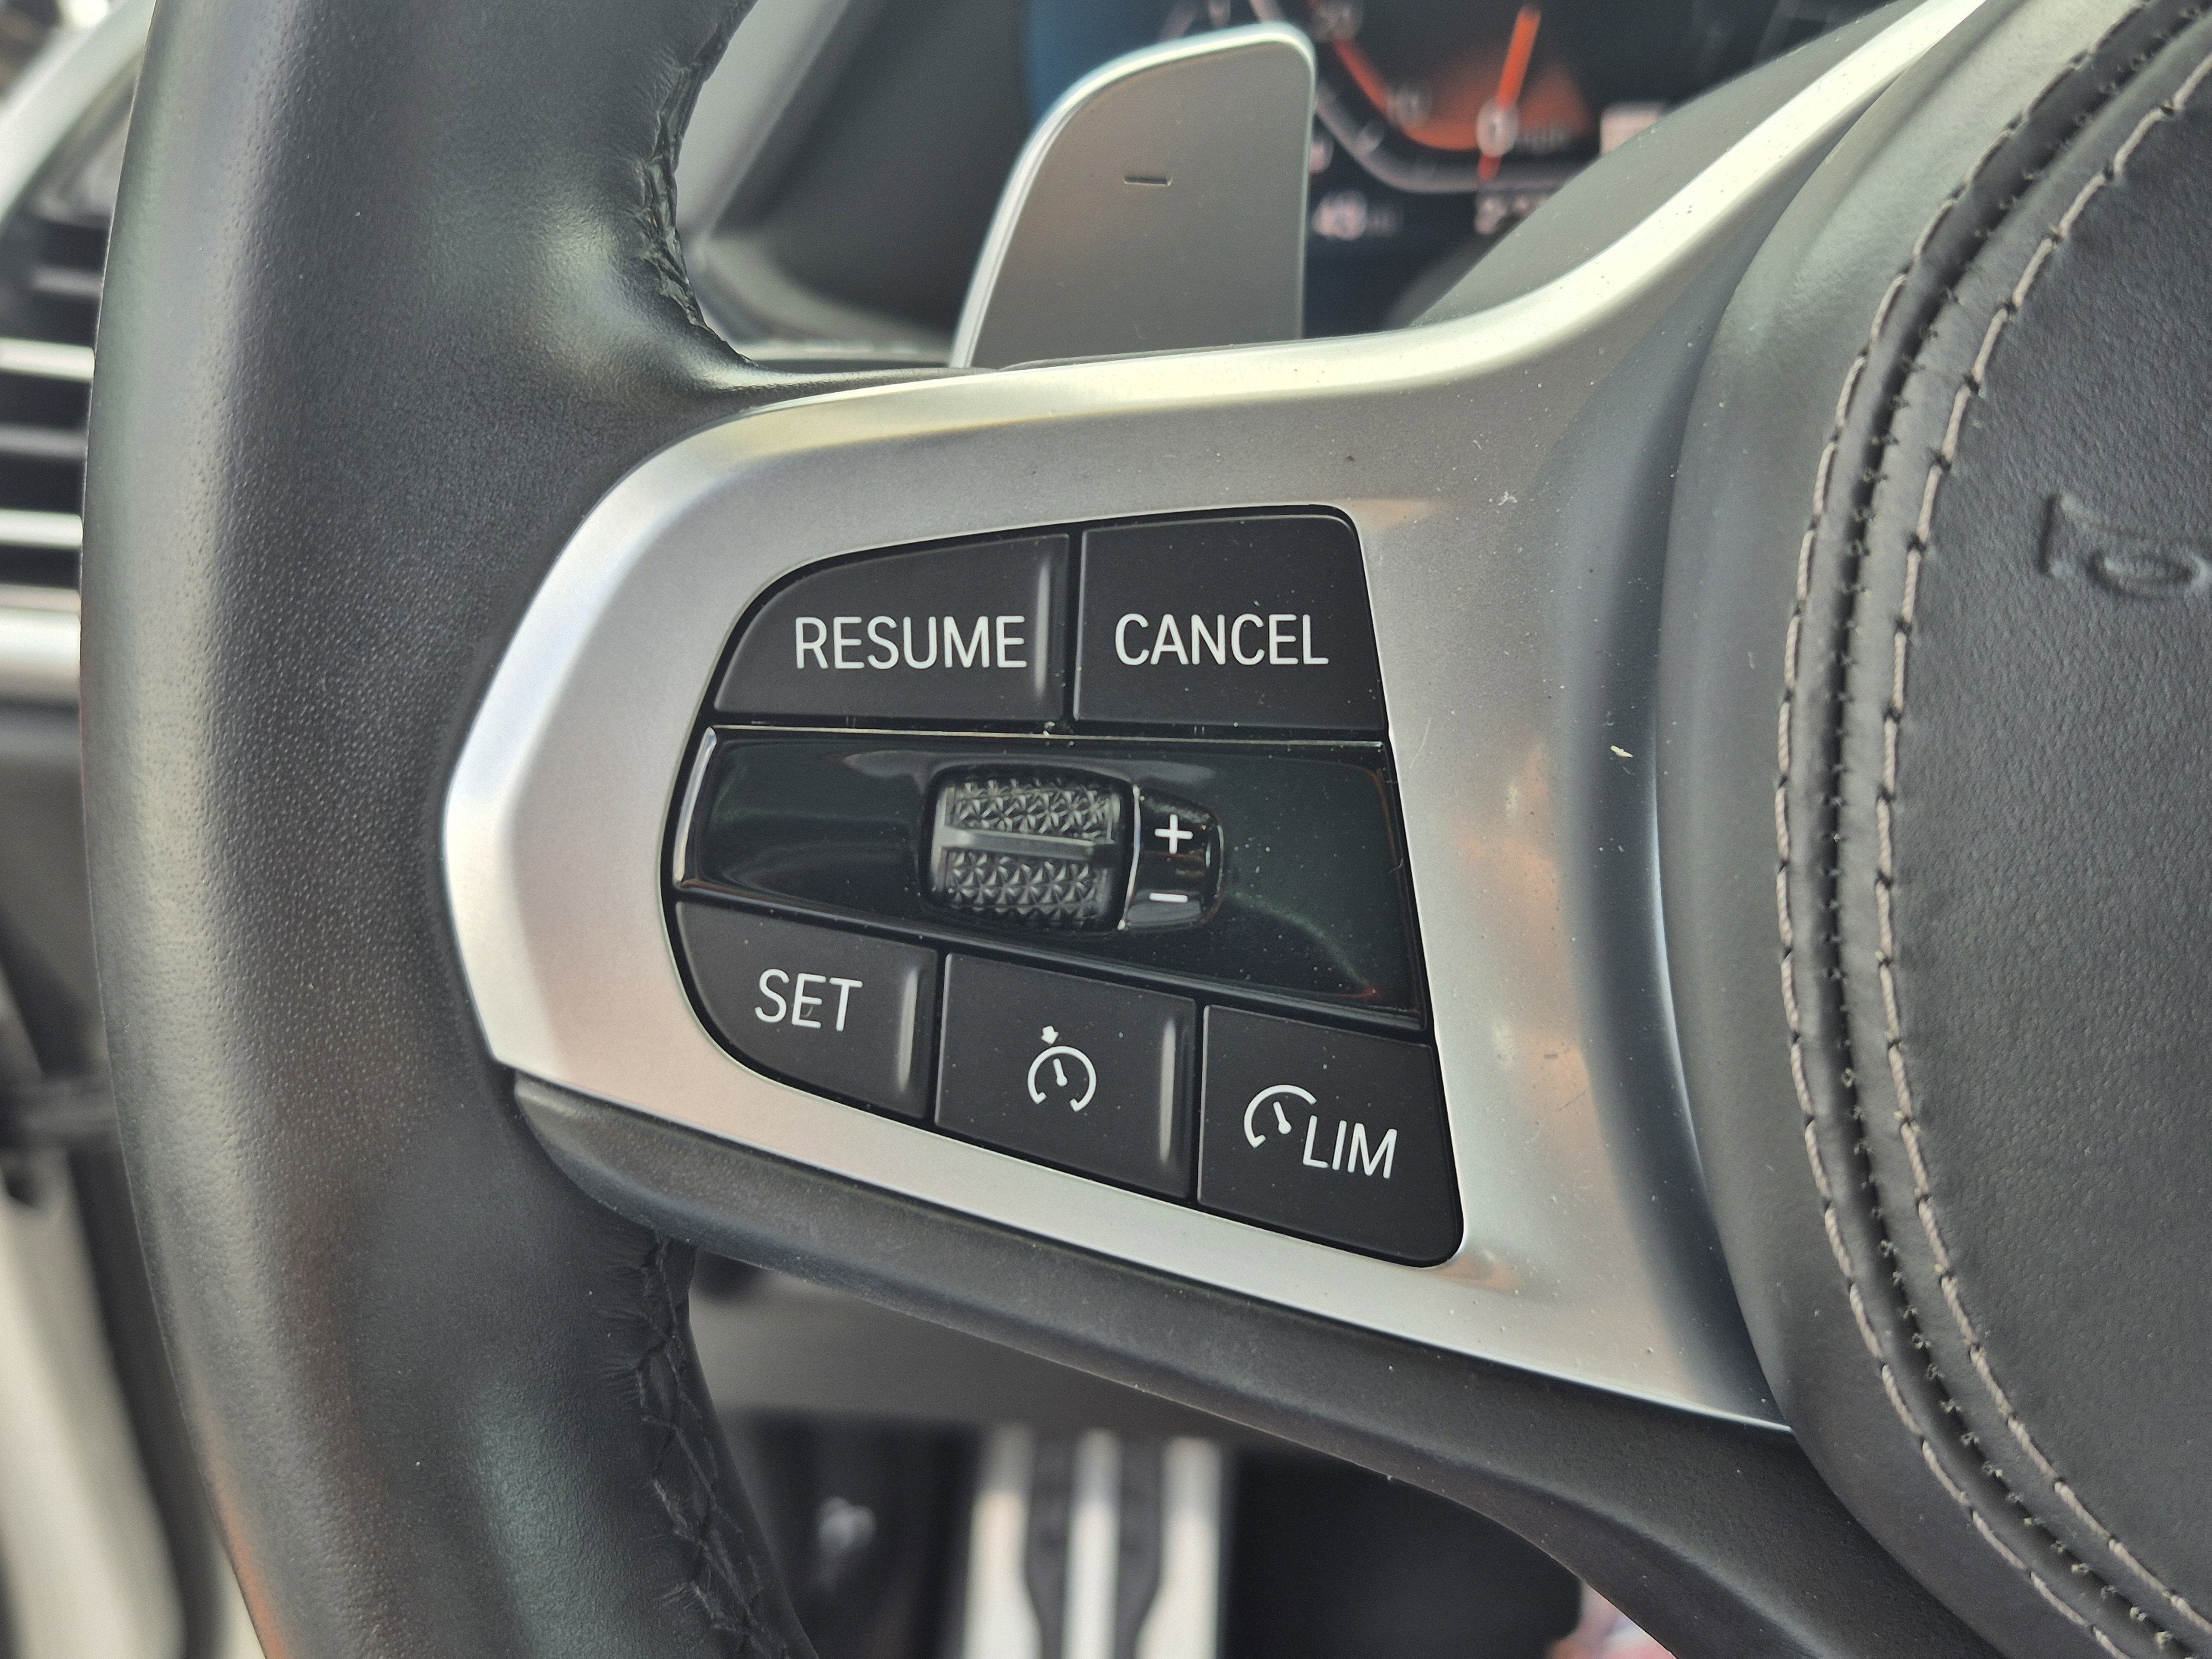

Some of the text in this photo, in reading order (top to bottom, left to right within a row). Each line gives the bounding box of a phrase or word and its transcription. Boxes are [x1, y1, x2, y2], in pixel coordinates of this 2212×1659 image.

[795, 615, 1027, 670] RESUME
[1115, 613, 1329, 666] CANCEL
[754, 968, 863, 1031] SET
[1302, 1115, 1397, 1179] LIM
